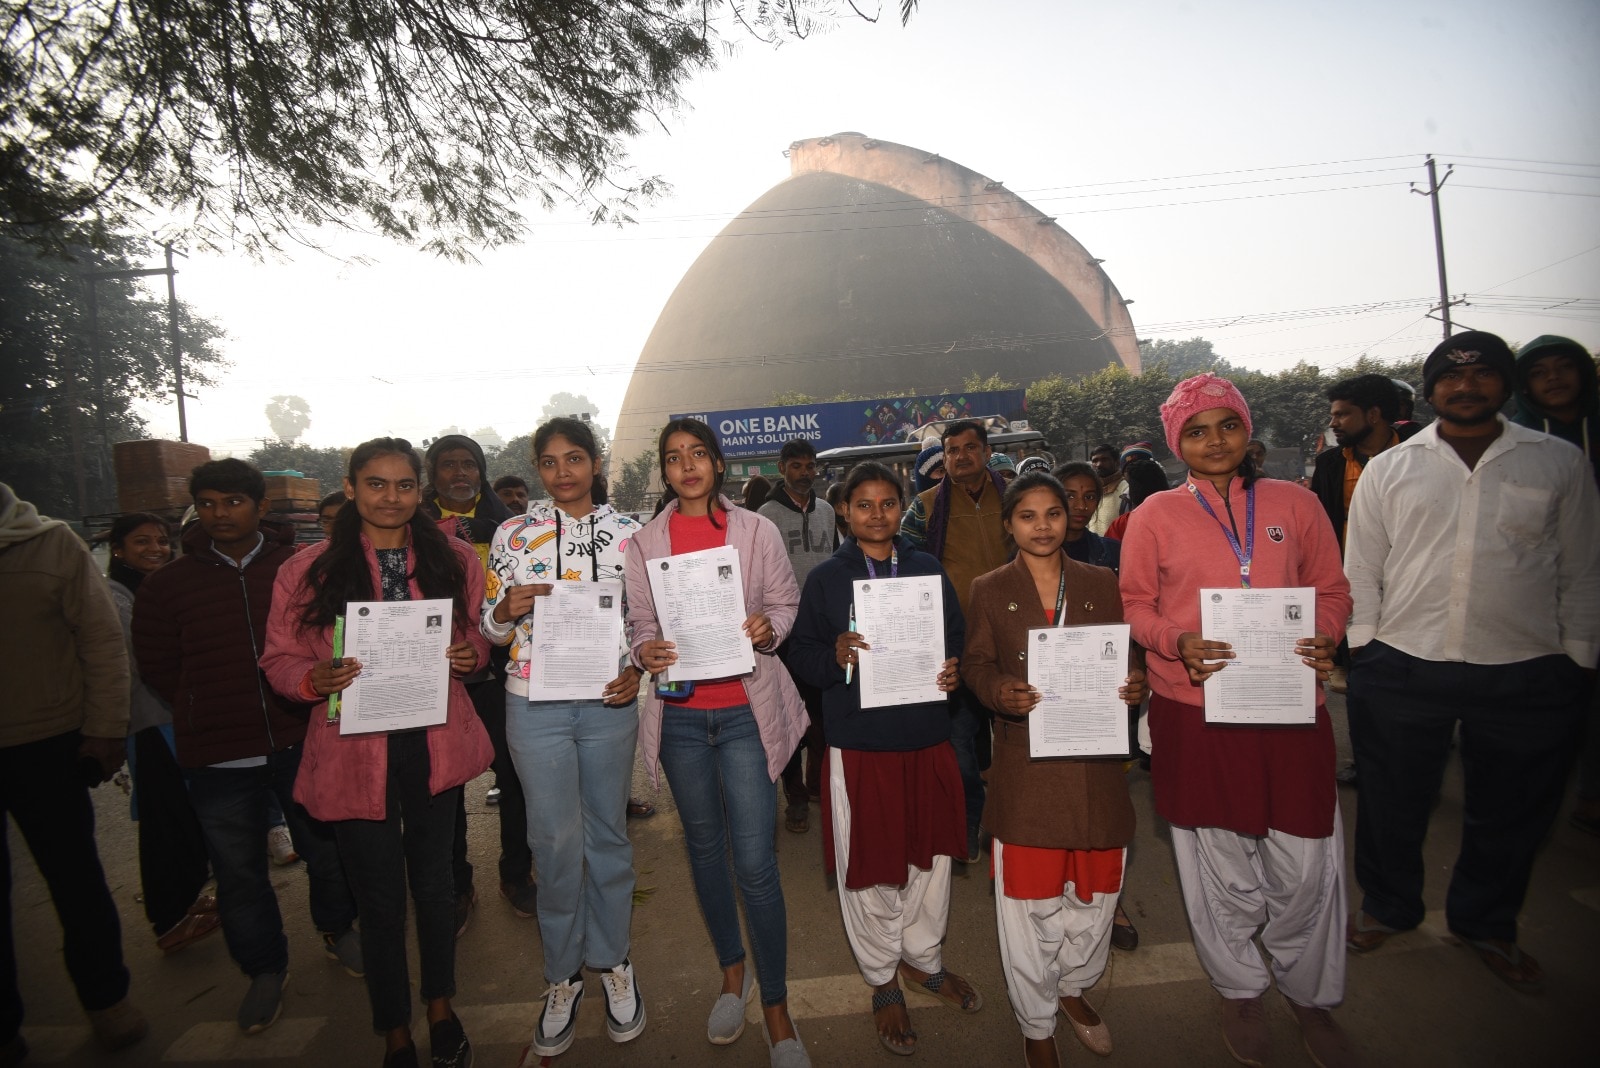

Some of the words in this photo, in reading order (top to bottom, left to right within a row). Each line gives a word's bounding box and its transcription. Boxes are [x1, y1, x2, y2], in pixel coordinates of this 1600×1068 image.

[719, 418, 760, 435] ONE
[763, 413, 820, 432] BANK
[722, 435, 755, 447] MANY
[756, 430, 822, 444] SOLUTIONS
